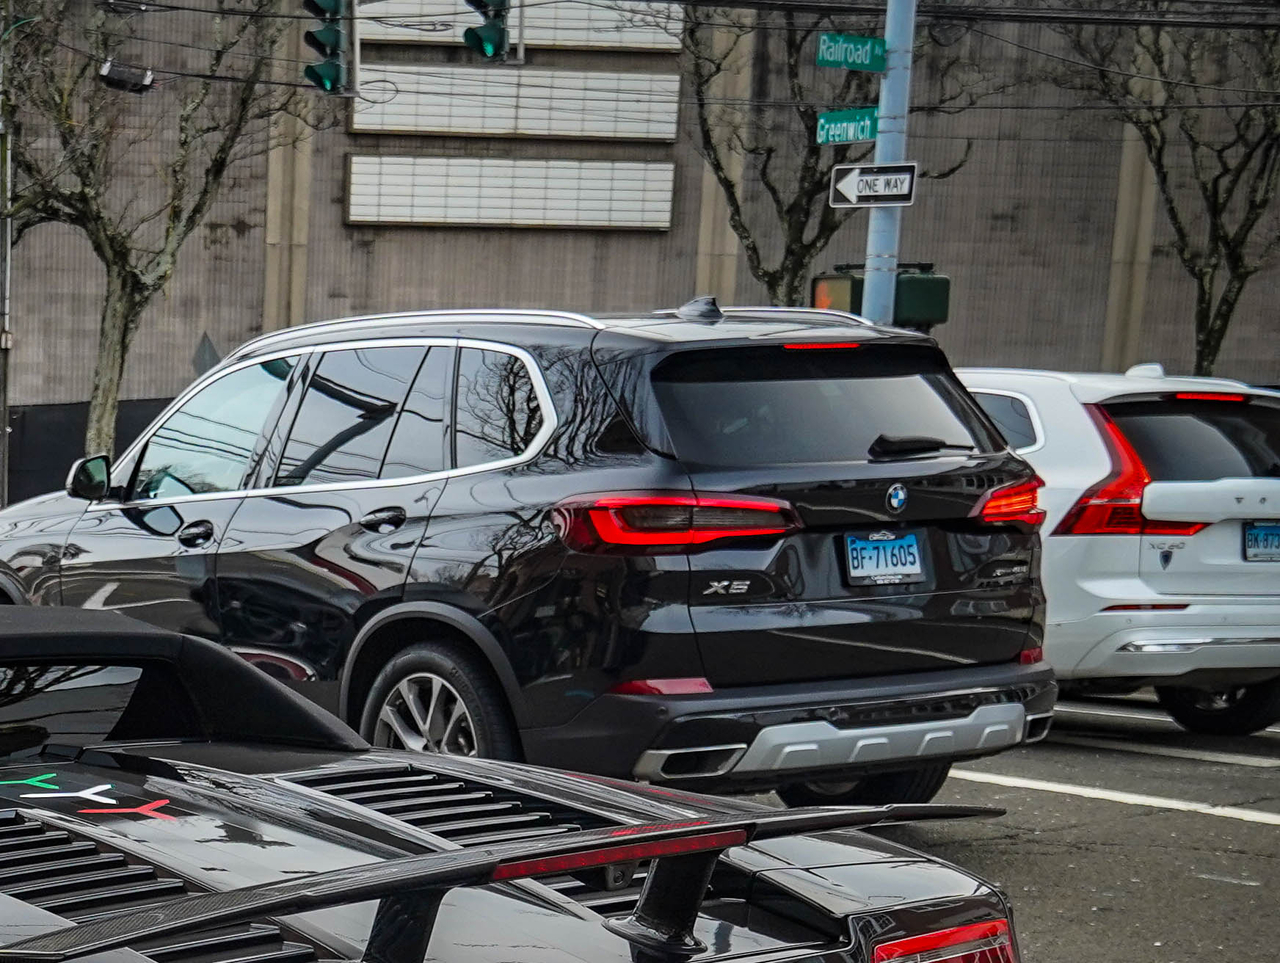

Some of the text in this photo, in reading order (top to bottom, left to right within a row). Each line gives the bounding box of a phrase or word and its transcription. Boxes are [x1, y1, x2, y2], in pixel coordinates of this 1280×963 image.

[818, 36, 870, 65] Railroad
[816, 115, 871, 144] Greenwich
[856, 176, 908, 194] ONE WAY
[702, 580, 751, 595] X5
